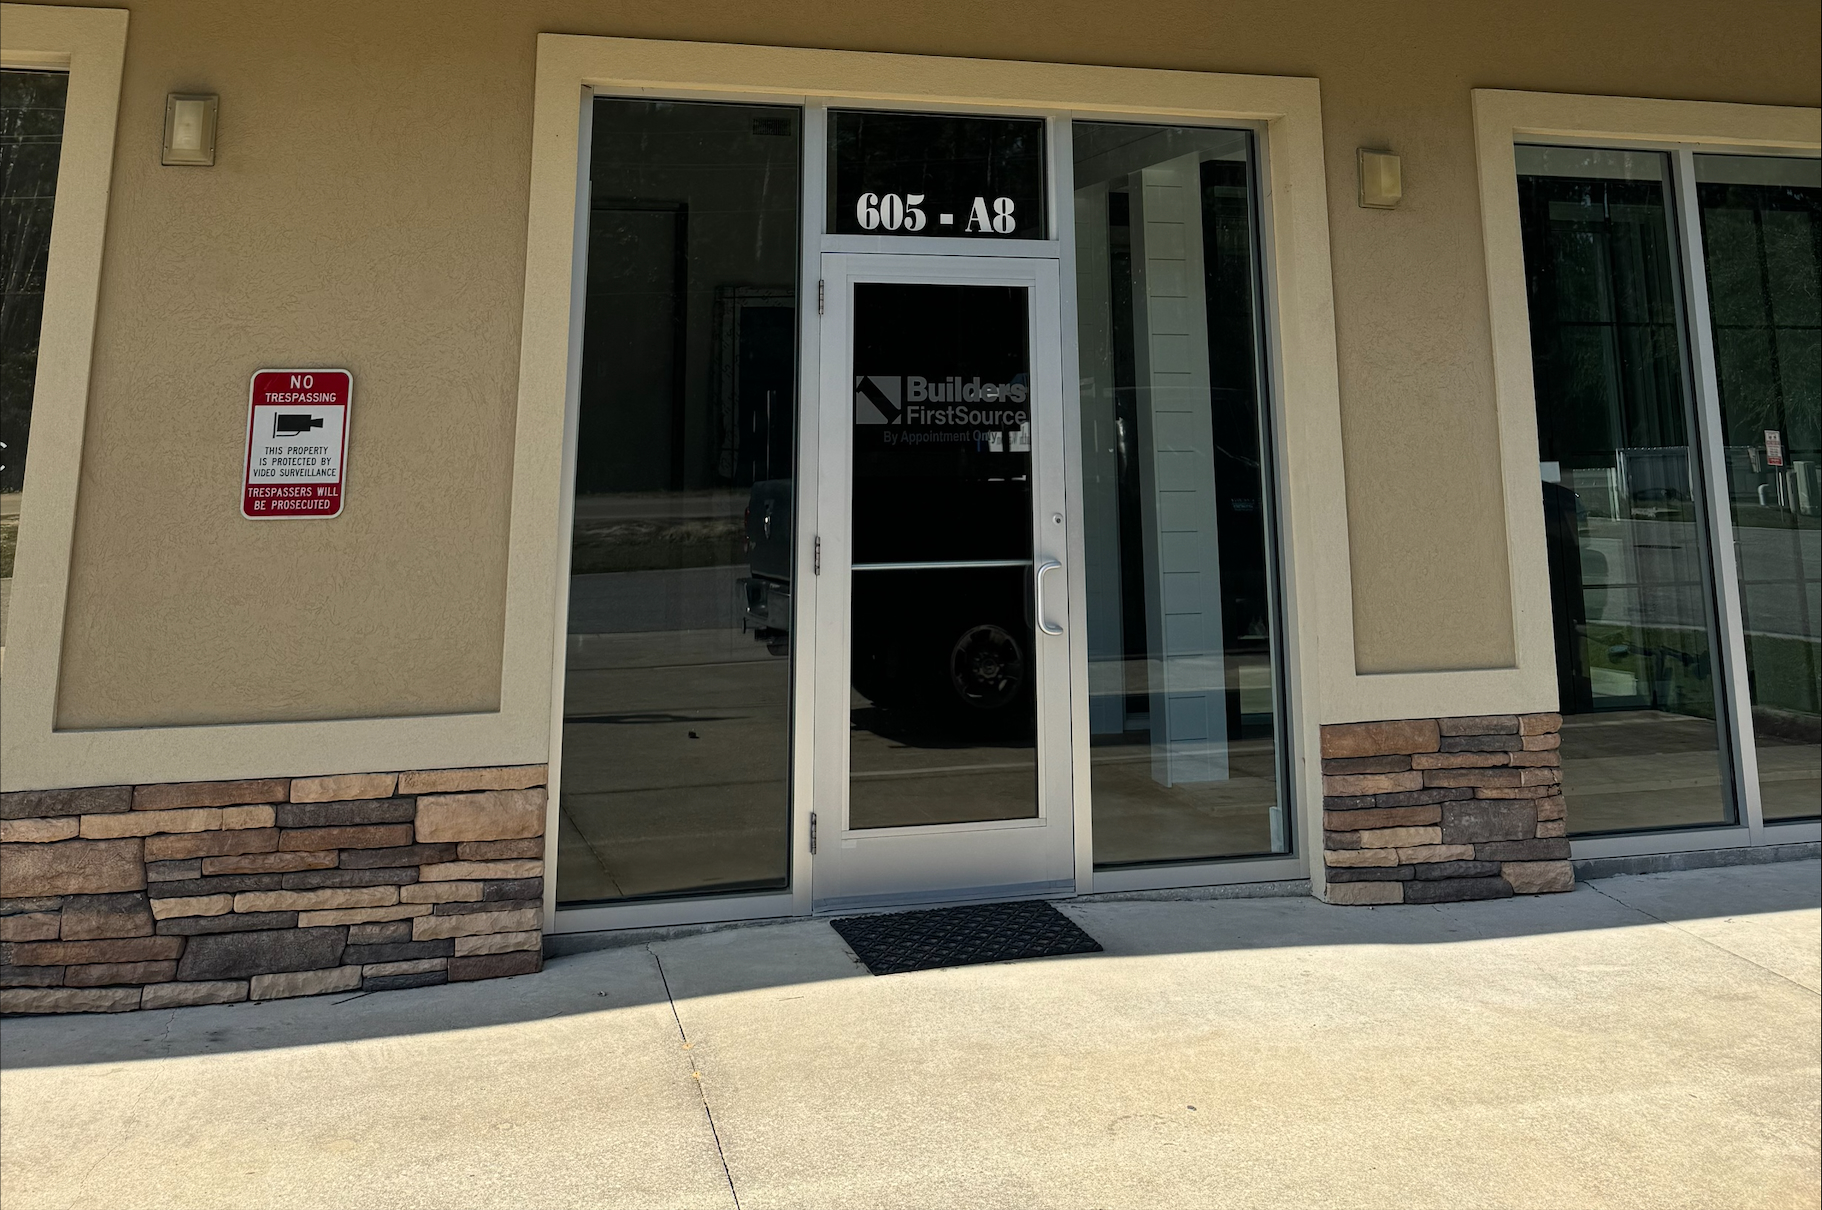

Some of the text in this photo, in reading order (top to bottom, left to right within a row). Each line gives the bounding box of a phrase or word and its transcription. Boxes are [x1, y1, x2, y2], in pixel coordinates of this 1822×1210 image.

[856, 192, 927, 231] 605
[965, 196, 1016, 234] A8
[290, 375, 314, 389] NO
[907, 375, 1027, 403] Builders
[265, 392, 337, 403] TRESPASSING
[906, 405, 1027, 425] FirstSource
[883, 430, 897, 445] By
[901, 429, 970, 445] Appointment
[973, 429, 998, 445] Only
[265, 446, 329, 455] THIS PROPERTY
[259, 457, 332, 466] IS PROTECTED BY
[253, 468, 337, 477] VIDEO SURVEILLANCE
[248, 487, 339, 497] TRESPASSERS WILL
[254, 499, 331, 510] BE PROSECUTED
